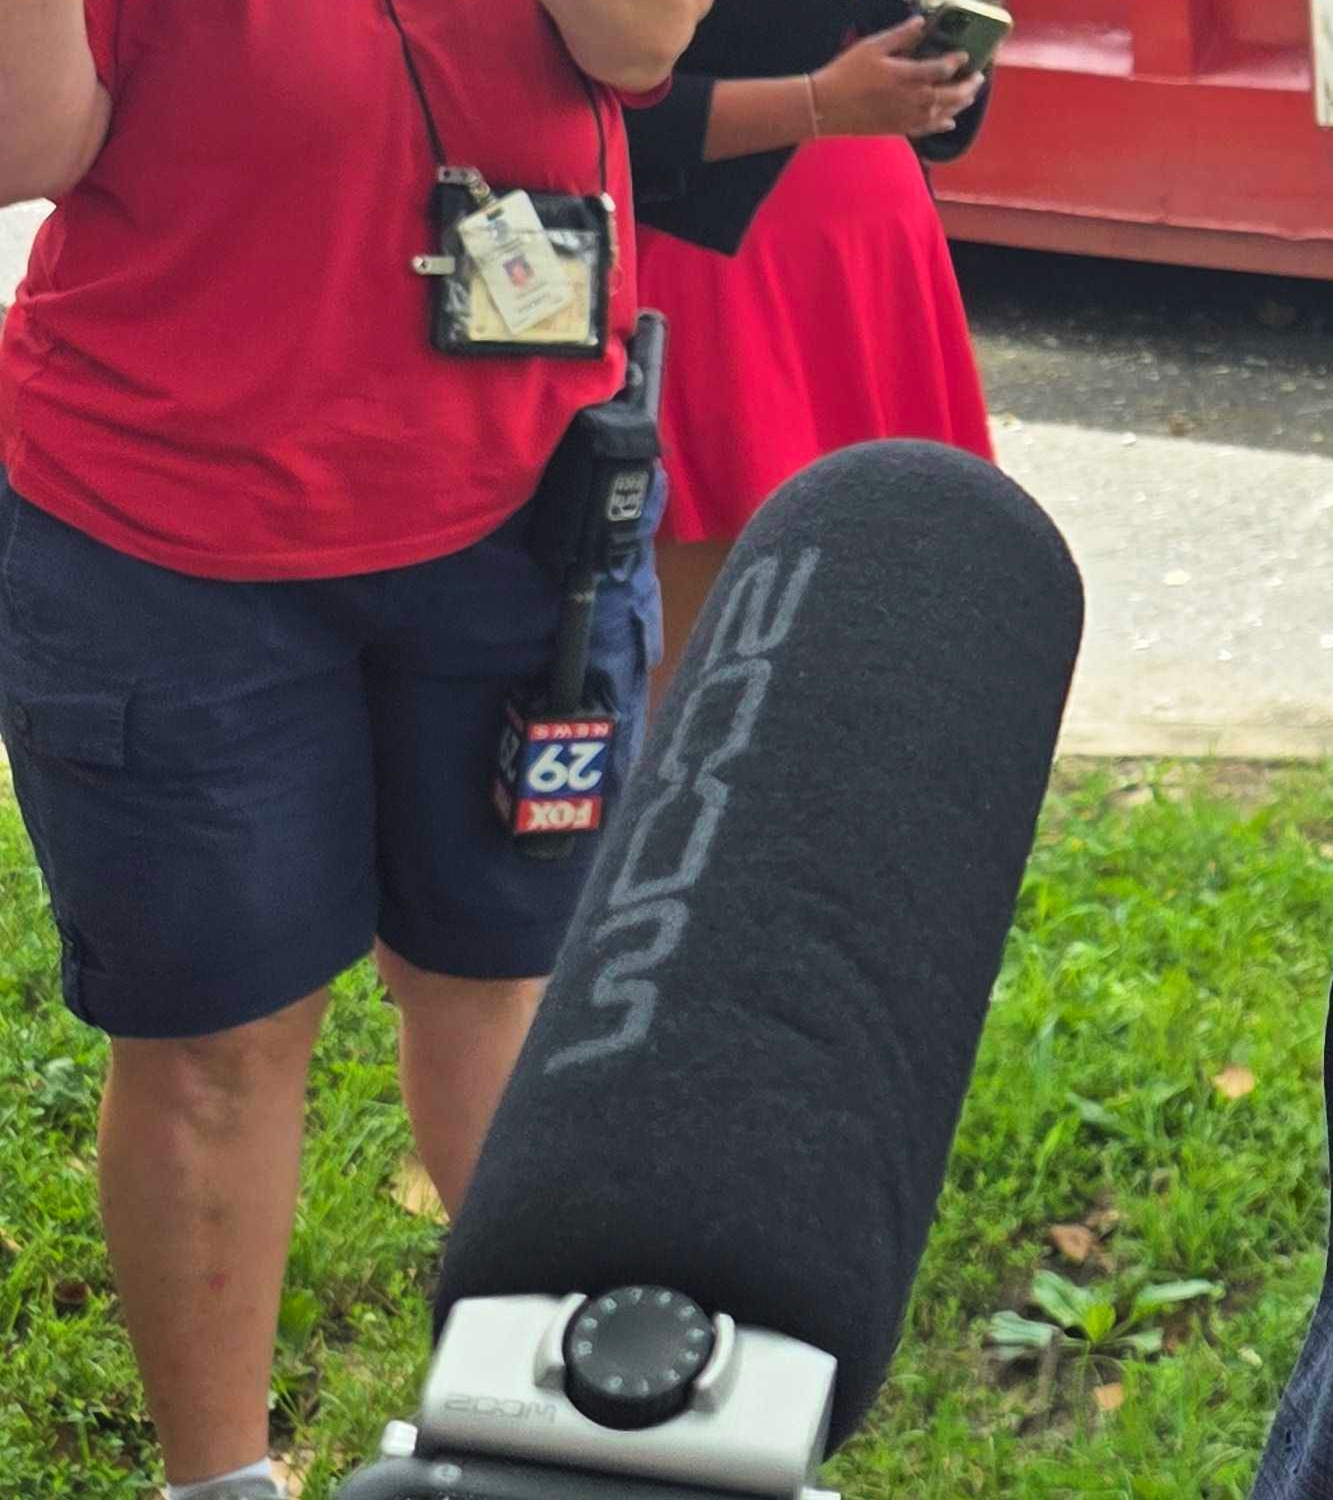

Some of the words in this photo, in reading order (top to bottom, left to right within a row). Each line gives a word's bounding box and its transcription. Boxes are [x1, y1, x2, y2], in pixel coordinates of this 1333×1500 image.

[531, 722, 610, 740] NEWS
[528, 742, 607, 794] 29
[527, 800, 594, 831] FOX
